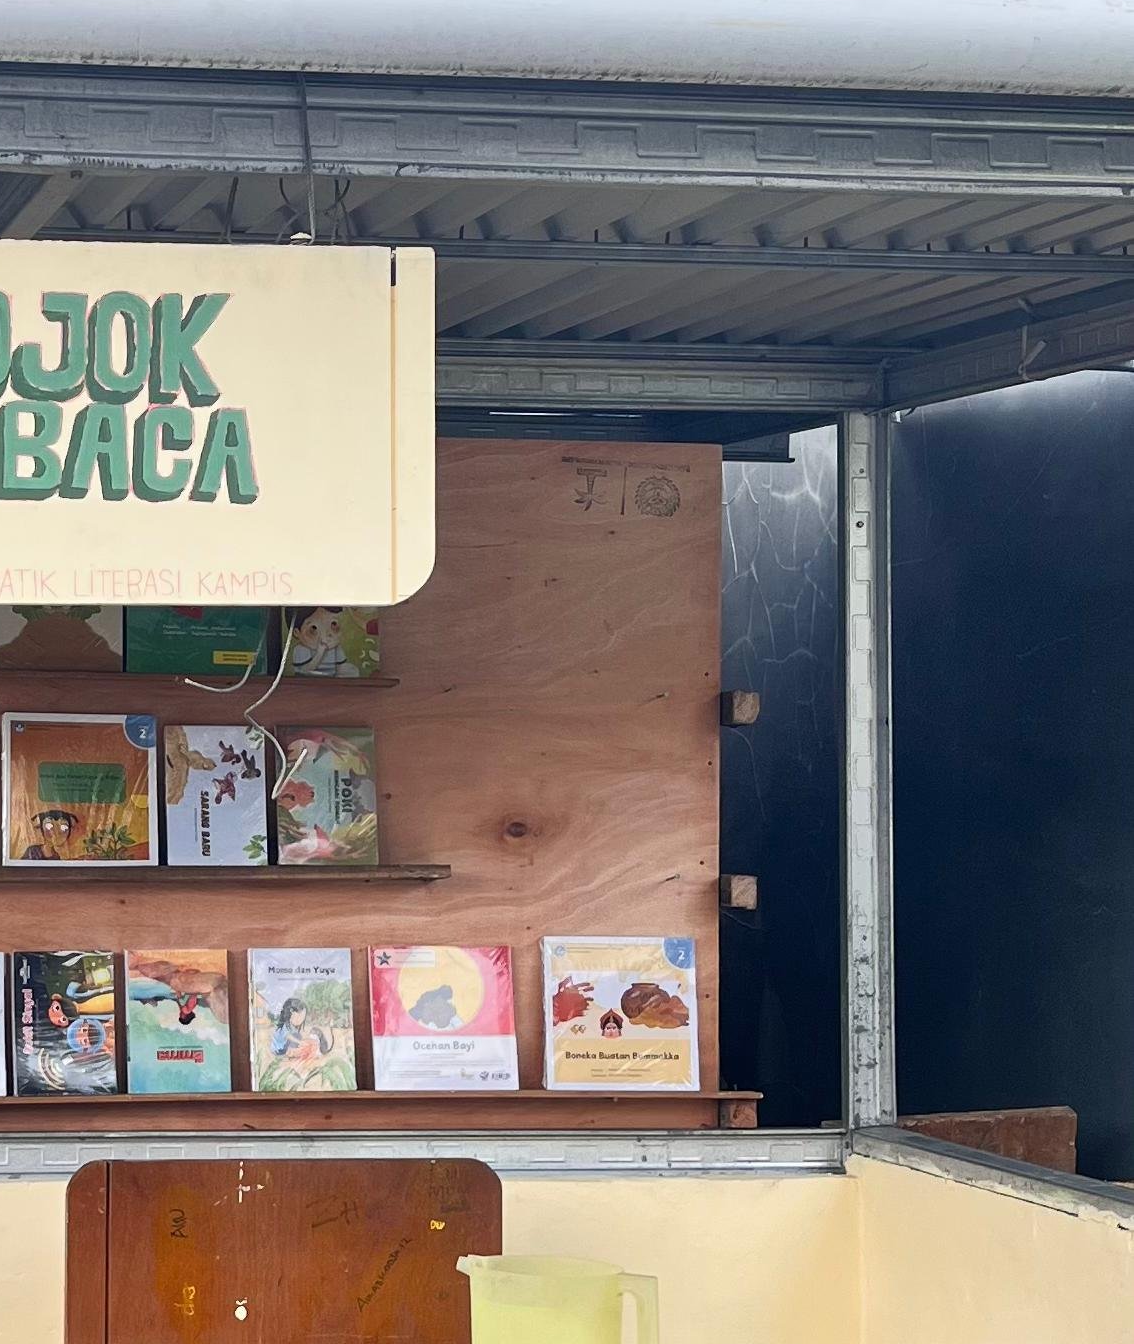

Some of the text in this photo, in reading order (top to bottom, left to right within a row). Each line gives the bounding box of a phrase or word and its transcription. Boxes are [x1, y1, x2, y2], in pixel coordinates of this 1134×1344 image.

[74, 563, 180, 598] LITERASI
[413, 1040, 475, 1053] Ocehan Bayi
[565, 1051, 597, 1060] Boneka
[599, 1051, 631, 1060] Buatan
